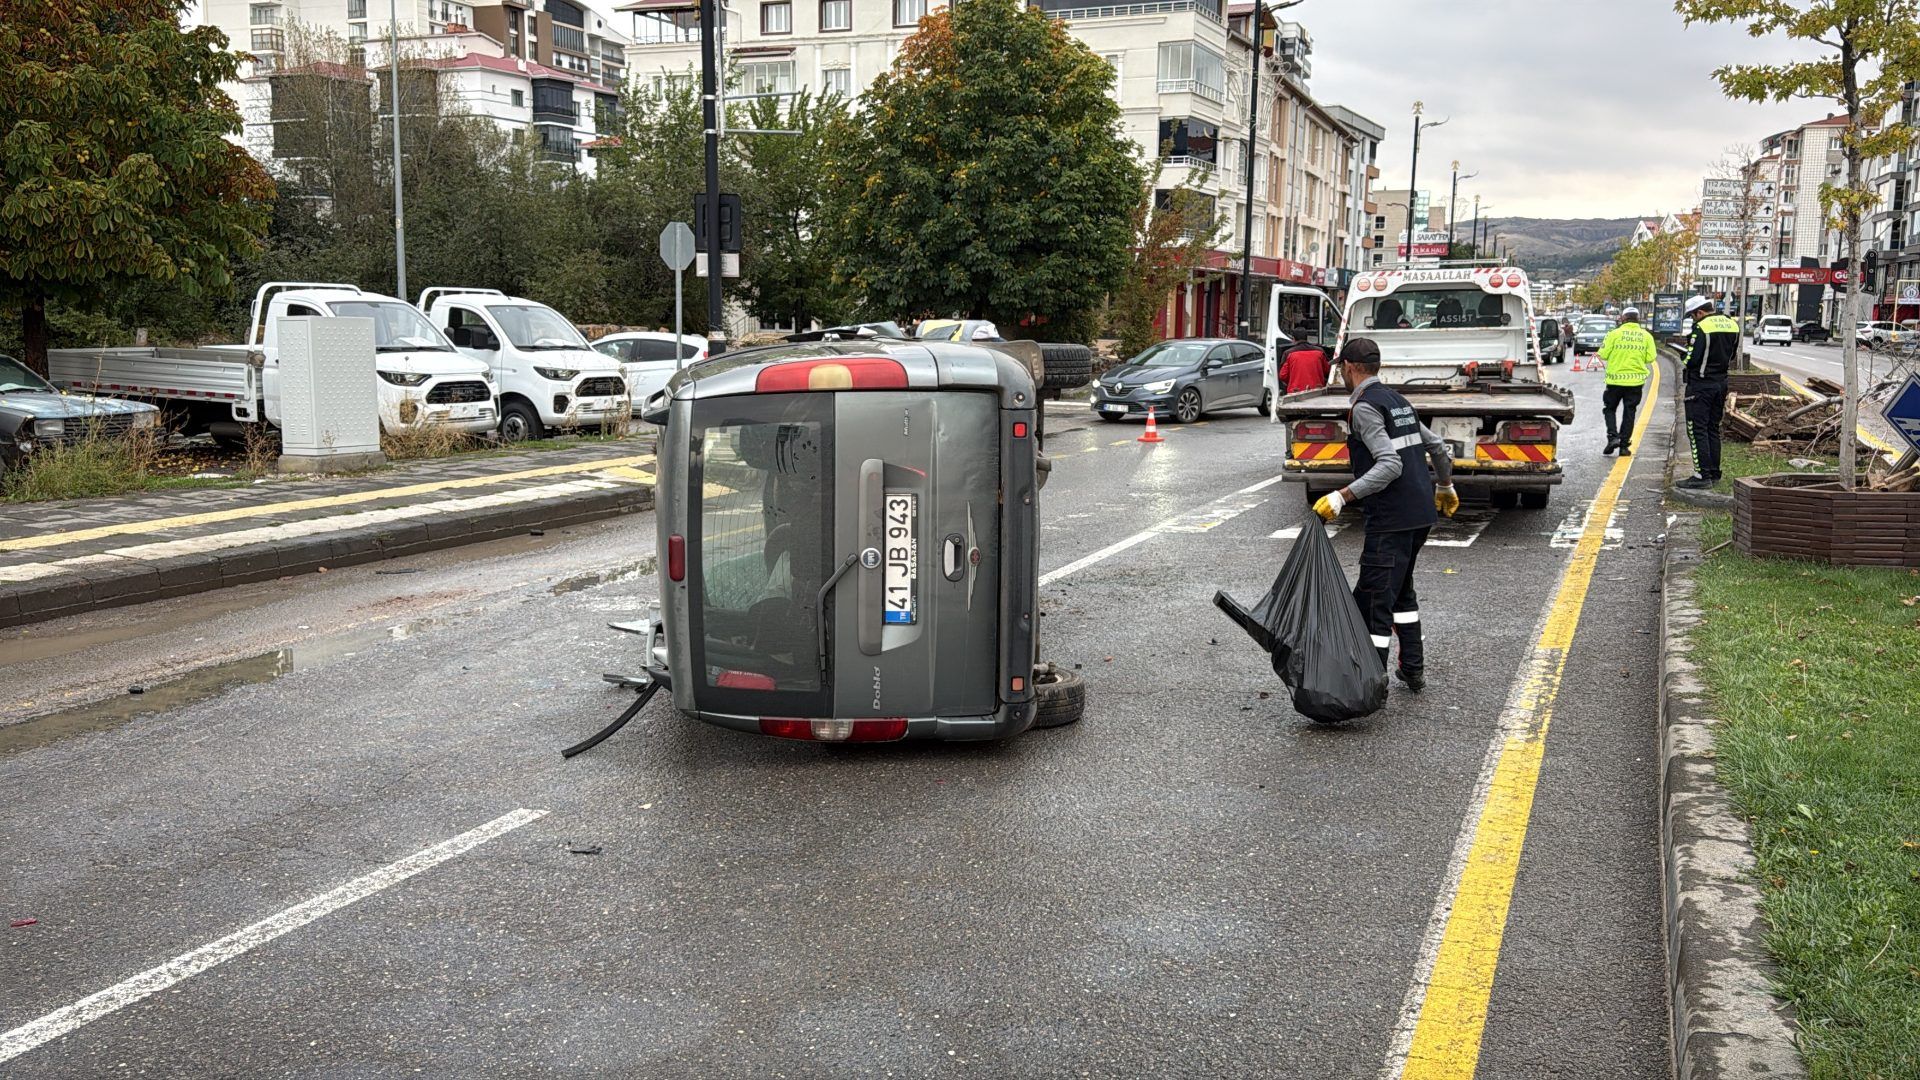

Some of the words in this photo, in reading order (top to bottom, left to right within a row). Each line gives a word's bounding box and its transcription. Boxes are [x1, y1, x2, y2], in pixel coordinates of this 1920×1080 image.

[1440, 313, 1473, 323] ASSIST
[887, 498, 908, 539] 943
[887, 547, 908, 578] JB
[887, 585, 908, 610] 41
